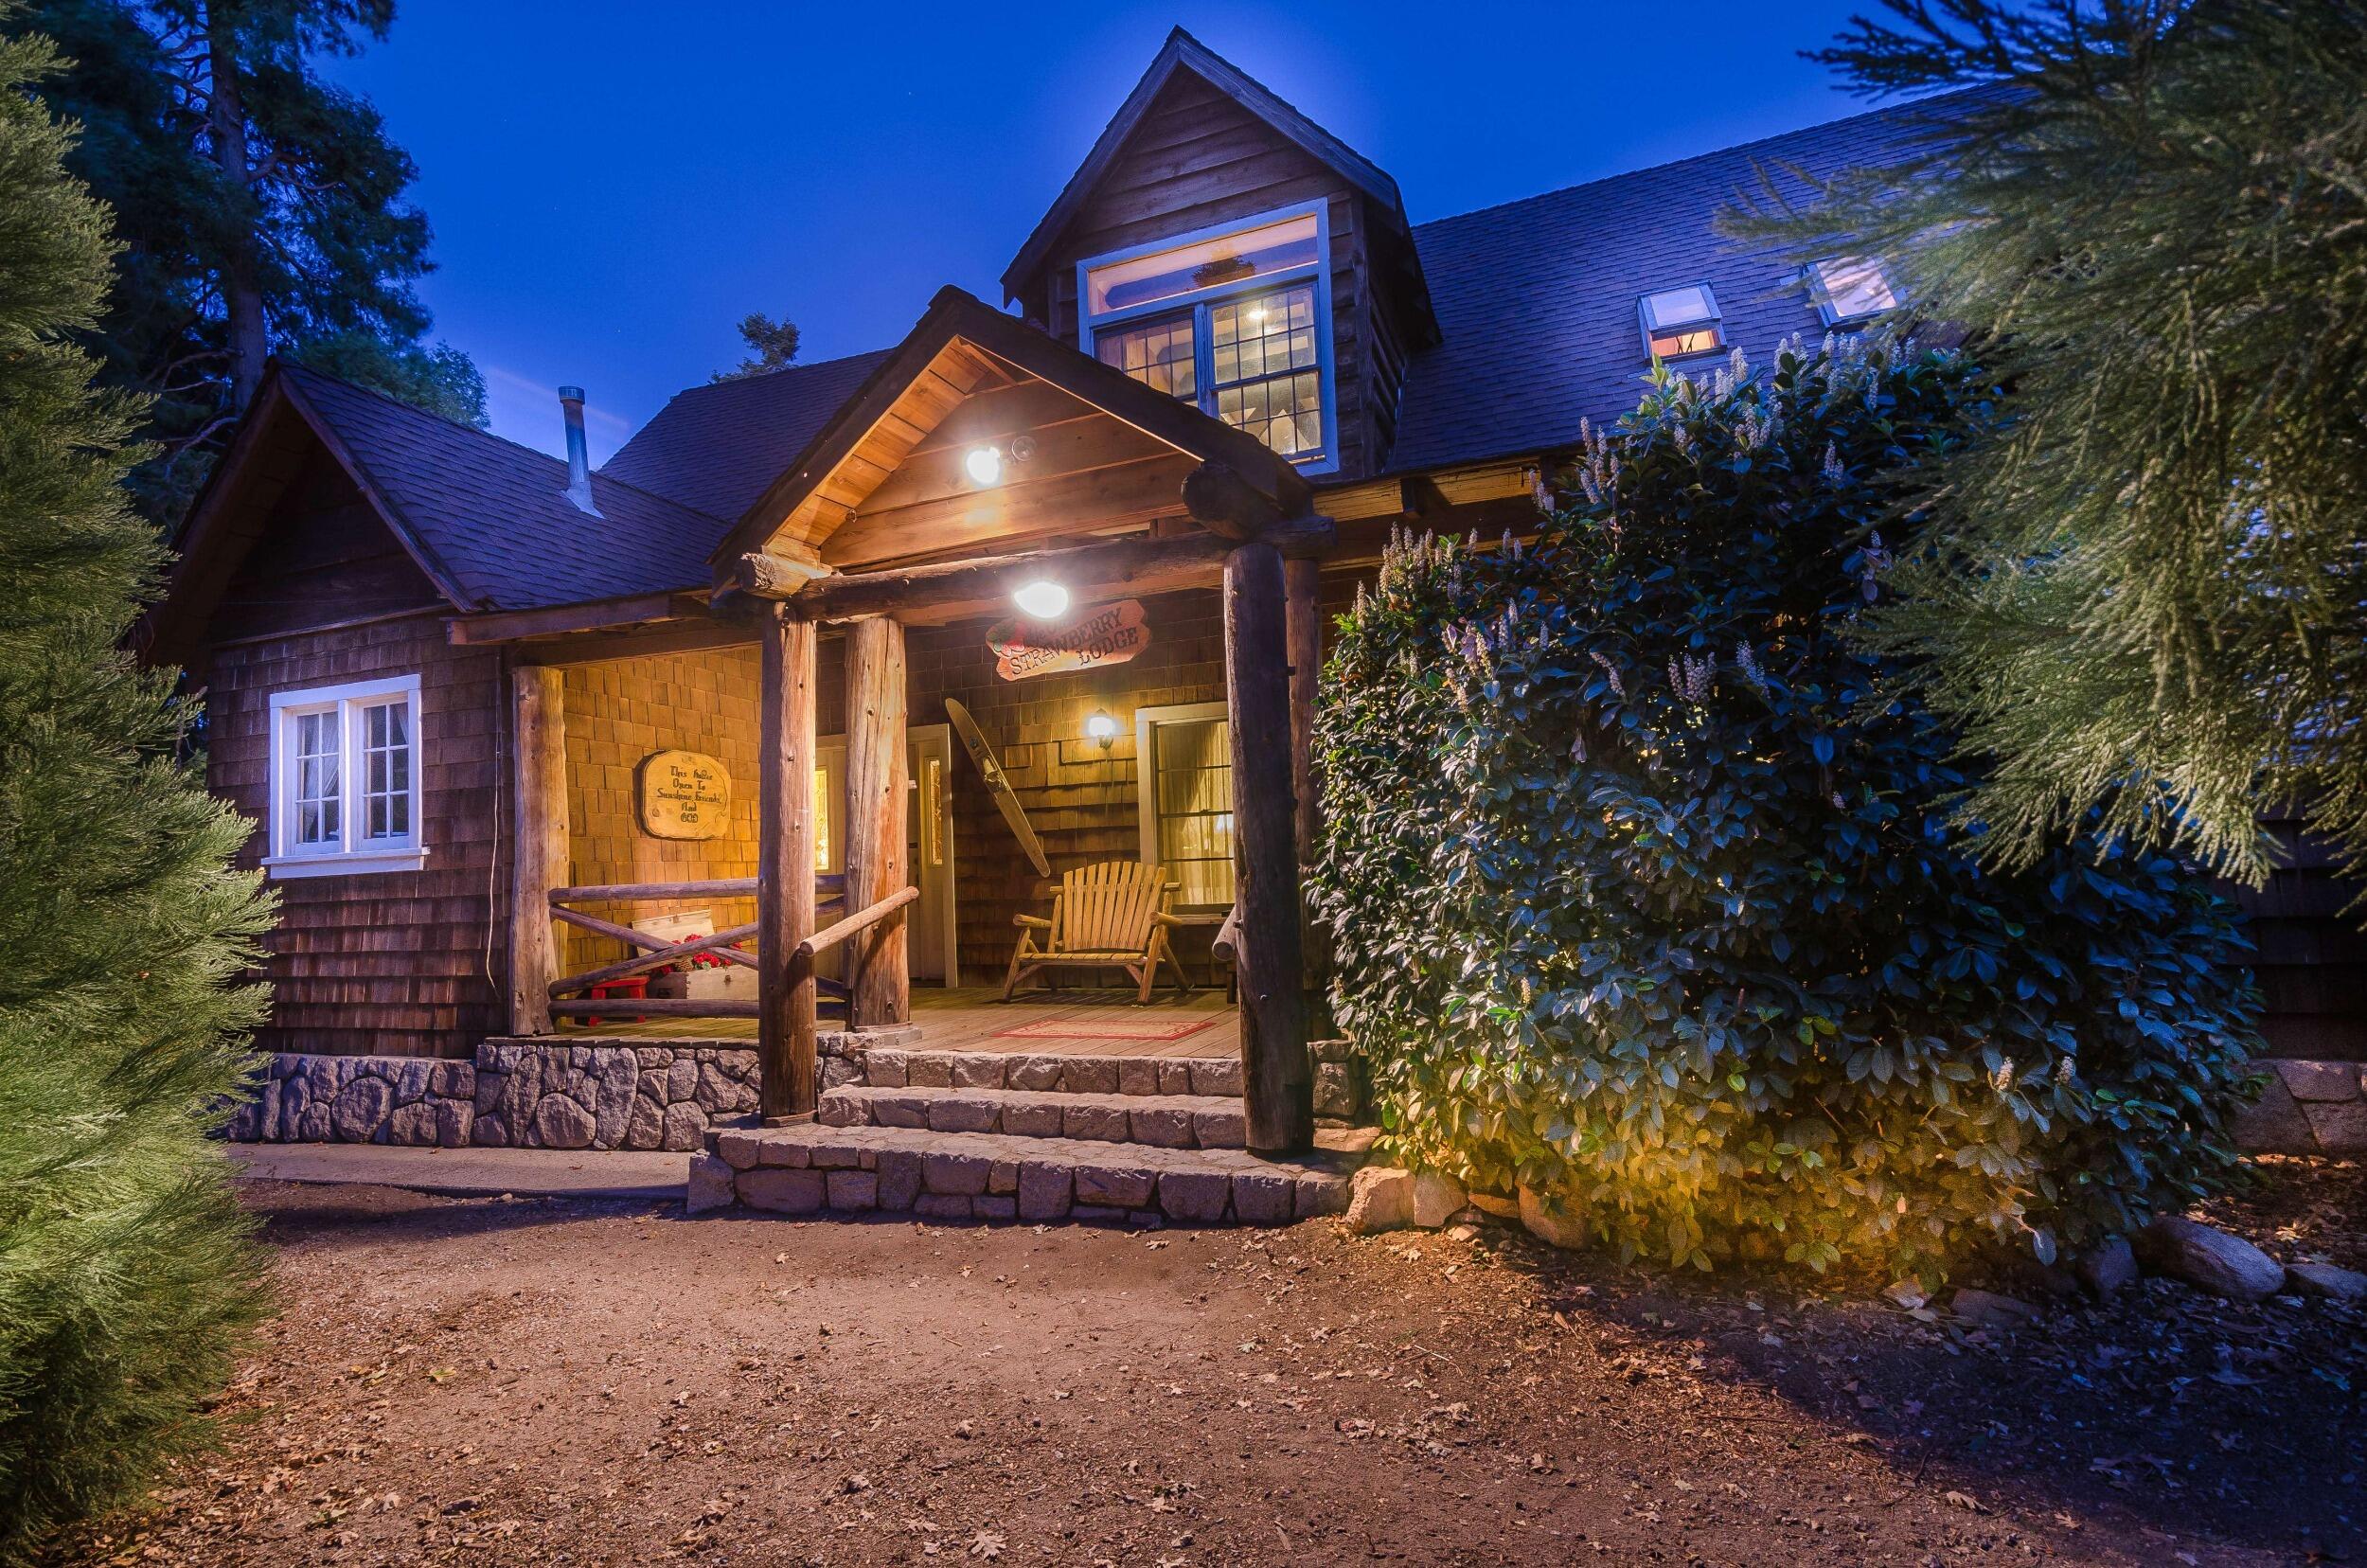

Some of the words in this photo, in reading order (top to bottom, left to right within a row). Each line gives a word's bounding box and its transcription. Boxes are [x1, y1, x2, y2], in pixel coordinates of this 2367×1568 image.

[1009, 607, 1122, 675] STRAWBERRY
[1076, 627, 1139, 666] LODGE
[670, 765, 687, 777] This
[672, 778, 693, 789] Open
[697, 780, 705, 791] To
[682, 802, 697, 811] And
